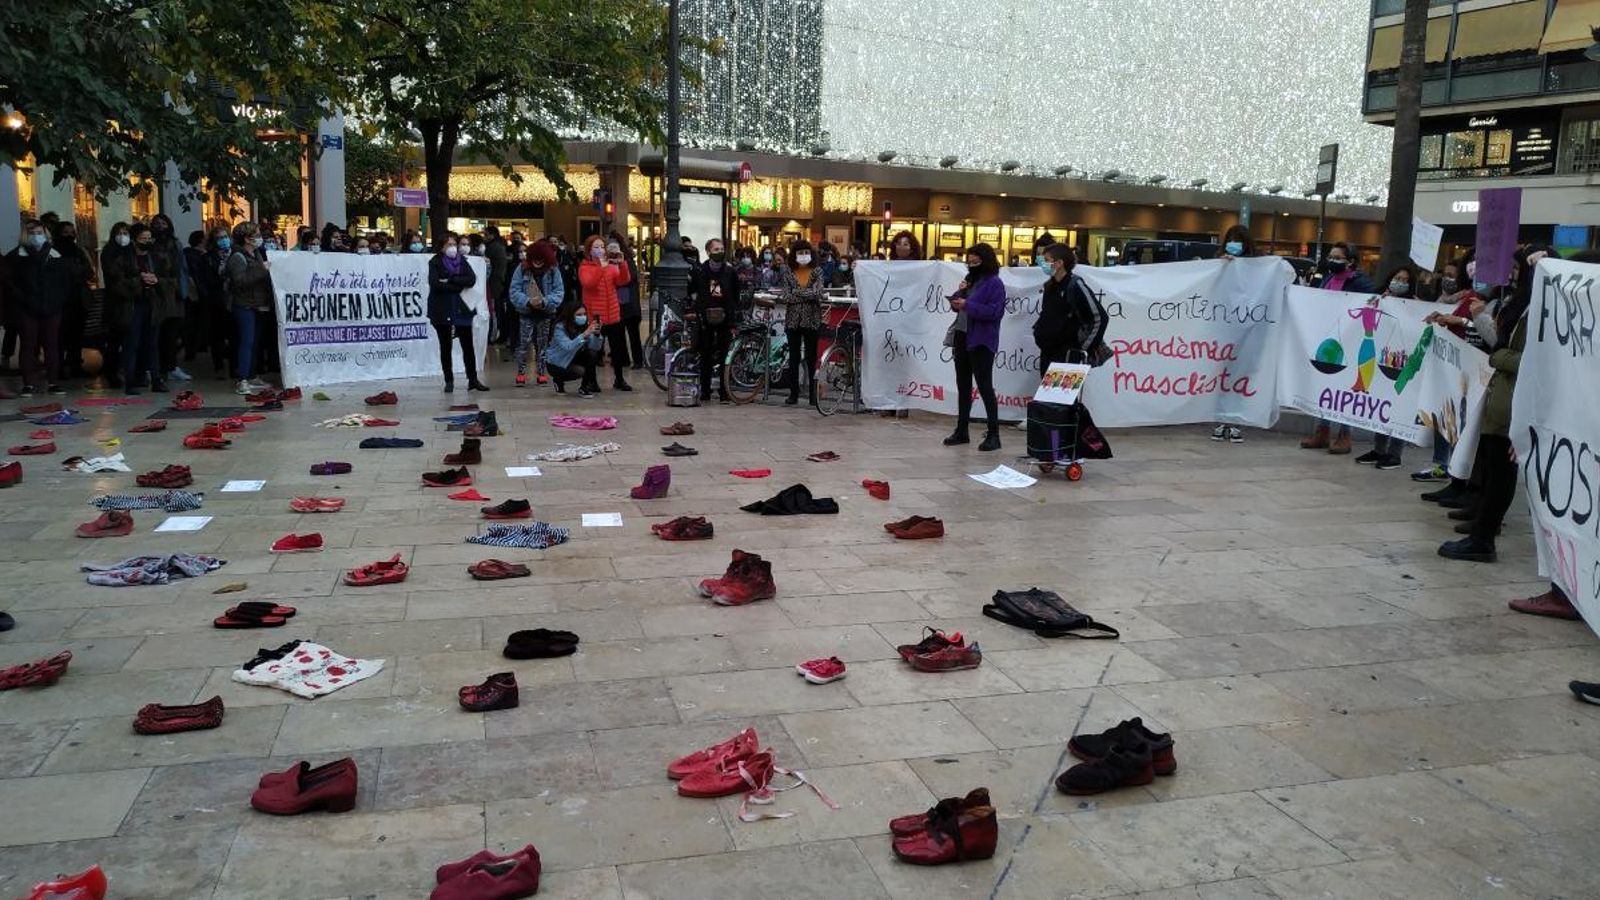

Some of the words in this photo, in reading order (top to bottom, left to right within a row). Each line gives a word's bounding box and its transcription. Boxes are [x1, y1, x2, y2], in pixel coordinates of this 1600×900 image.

[285, 294, 363, 323] RESPONEM
[366, 291, 422, 320] JUNTES
[873, 275, 906, 315] La
[1537, 274, 1596, 357] FORA
[346, 327, 357, 341] DE
[359, 326, 386, 341] CLASSE
[1111, 336, 1238, 368] pandèmia
[895, 381, 945, 401] #25N
[1113, 367, 1257, 397] masclista
[1319, 387, 1392, 424] AIPHYC
